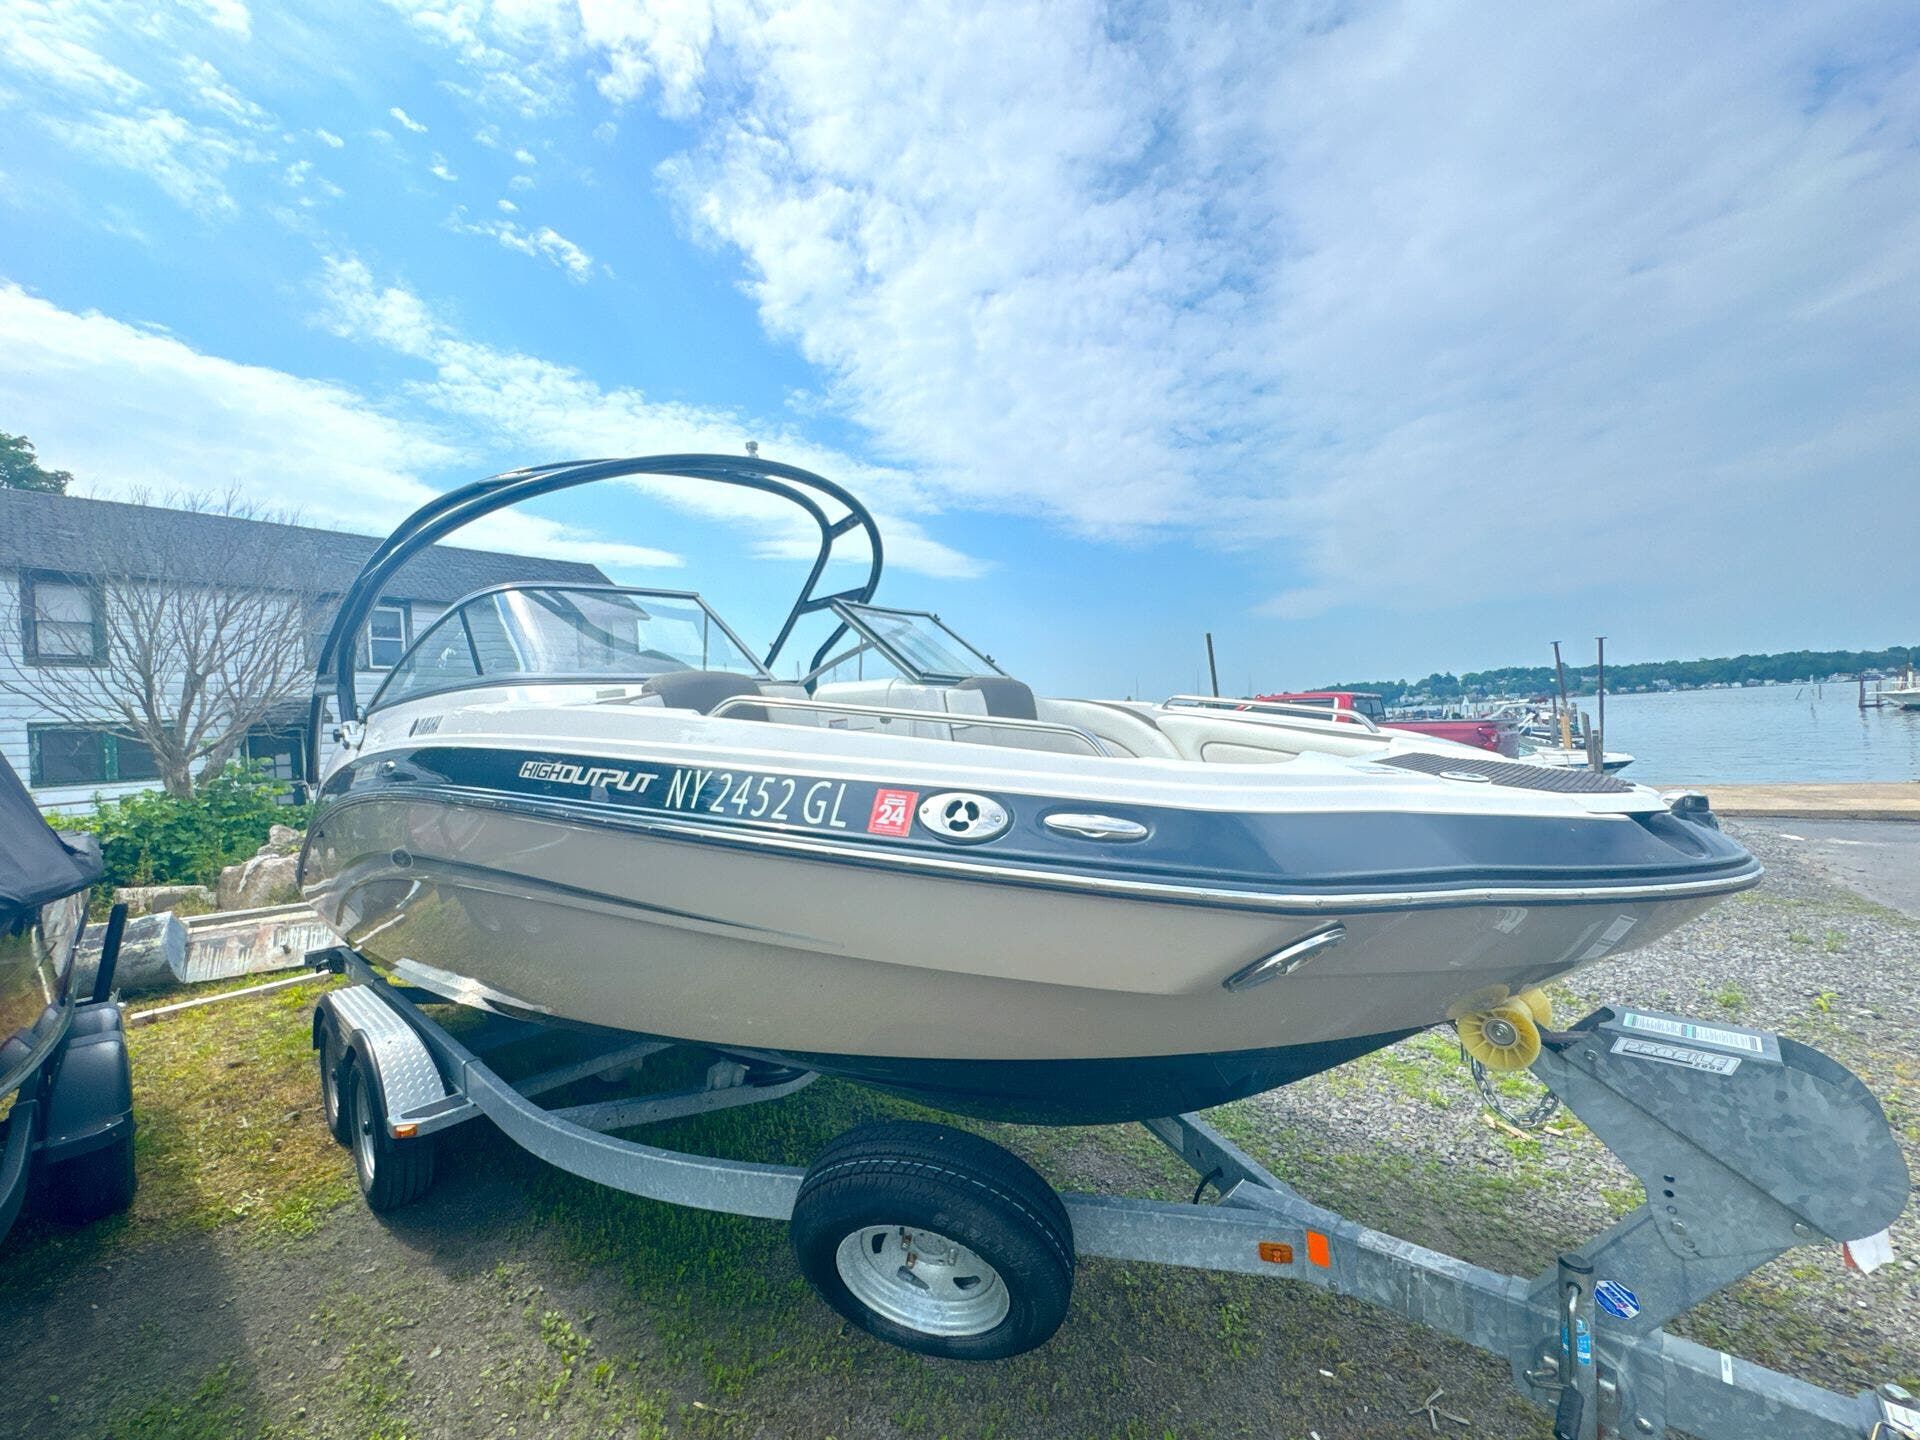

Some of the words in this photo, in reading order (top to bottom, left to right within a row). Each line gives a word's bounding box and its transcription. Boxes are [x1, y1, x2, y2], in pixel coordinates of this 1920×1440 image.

[665, 769, 713, 809] NY
[709, 773, 796, 820] 2452
[803, 780, 847, 828] GL
[875, 804, 905, 826] 24
[1622, 1040, 1729, 1068] PROFILE
